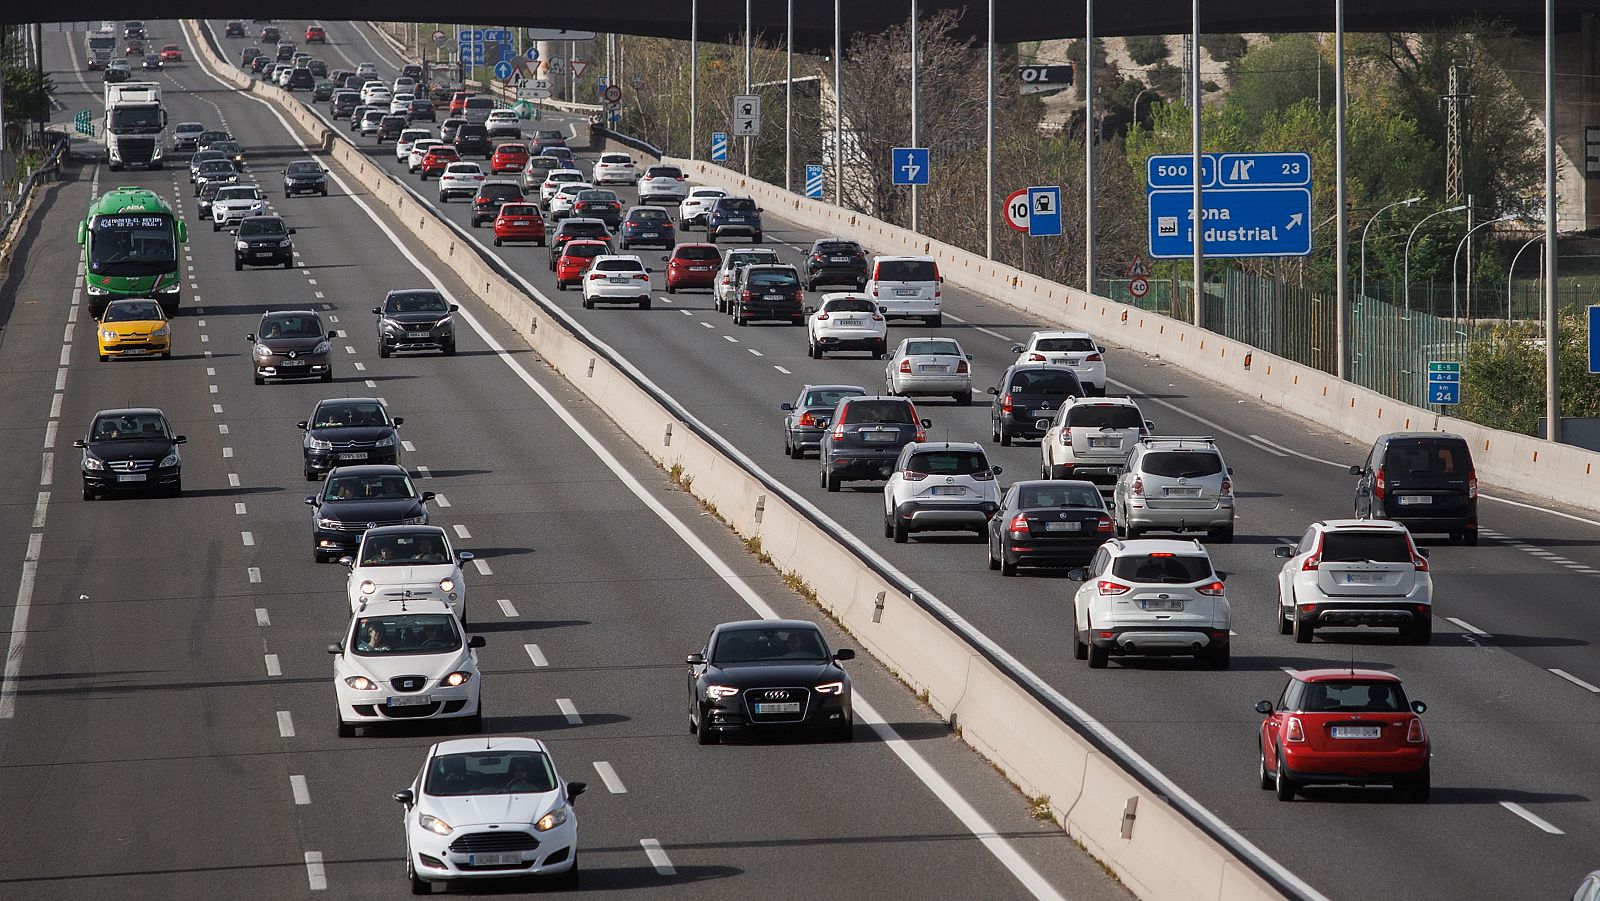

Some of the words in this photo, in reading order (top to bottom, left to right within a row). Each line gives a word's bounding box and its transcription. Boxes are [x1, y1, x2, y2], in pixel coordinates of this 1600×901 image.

[1020, 68, 1049, 81] OL
[1158, 165, 1187, 176] 500
[1282, 163, 1300, 175] 23
[1011, 203, 1028, 218] 10
[1187, 208, 1230, 220] zona
[1187, 226, 1278, 242] idustrial
[1436, 392, 1451, 401] 24
